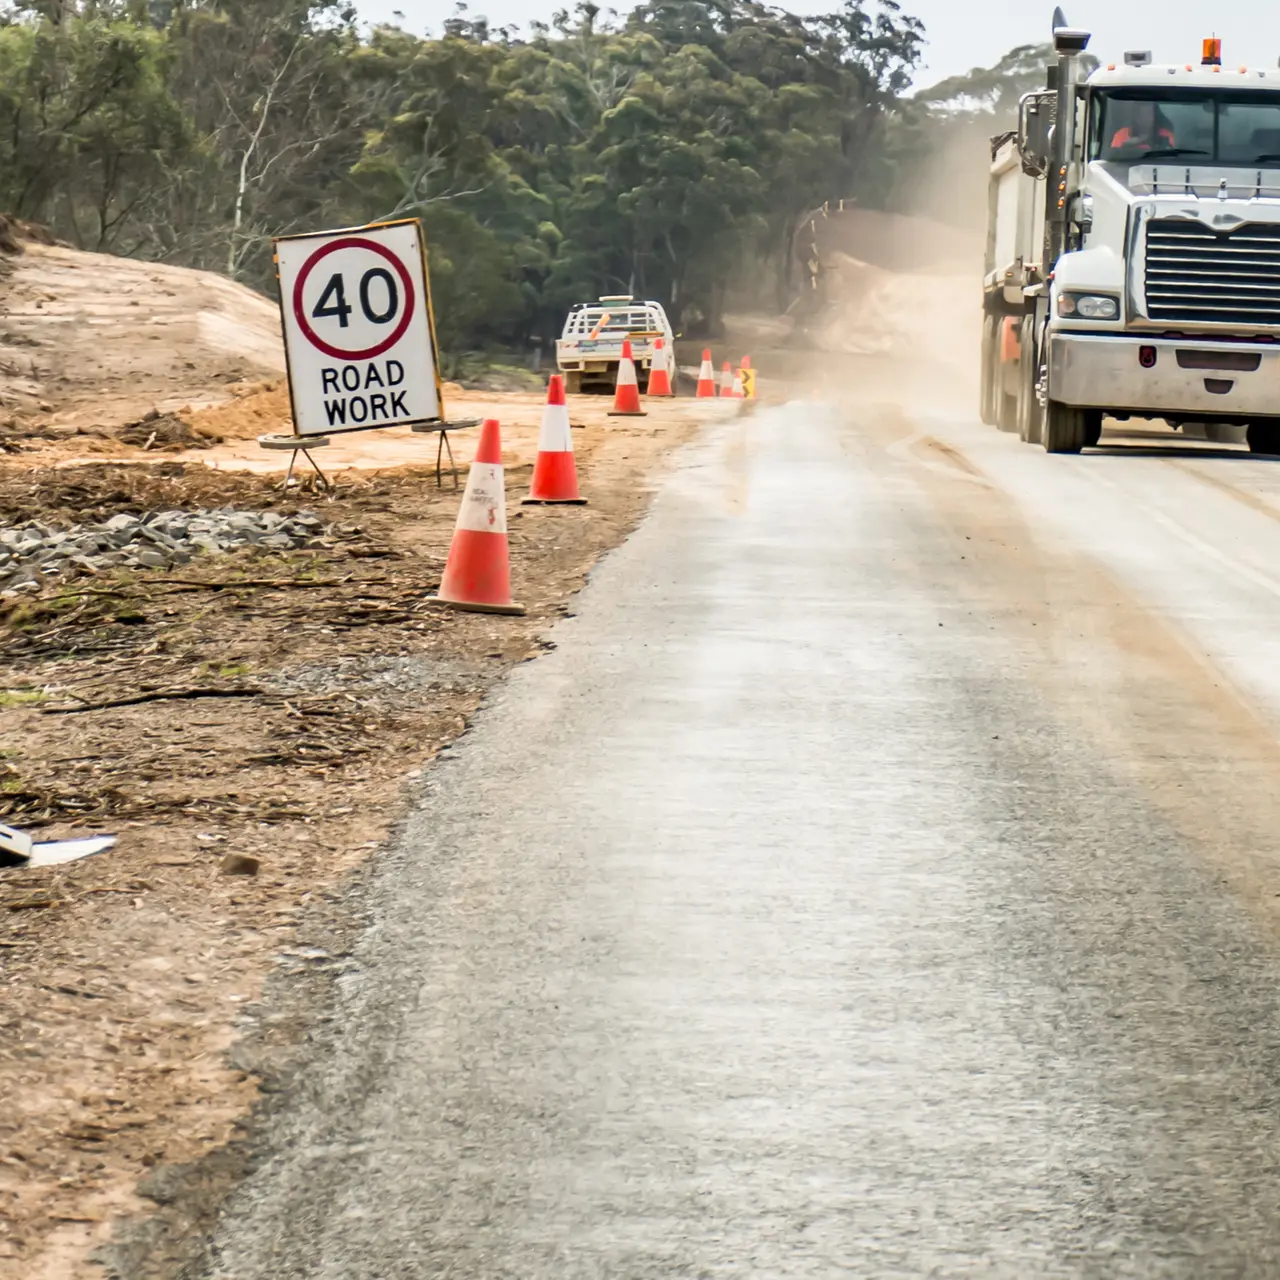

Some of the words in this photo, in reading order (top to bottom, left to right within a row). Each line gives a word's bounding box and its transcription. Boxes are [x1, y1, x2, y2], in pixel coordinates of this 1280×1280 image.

[312, 267, 399, 328] 40
[321, 360, 405, 394] ROAD
[324, 390, 411, 426] WORK
